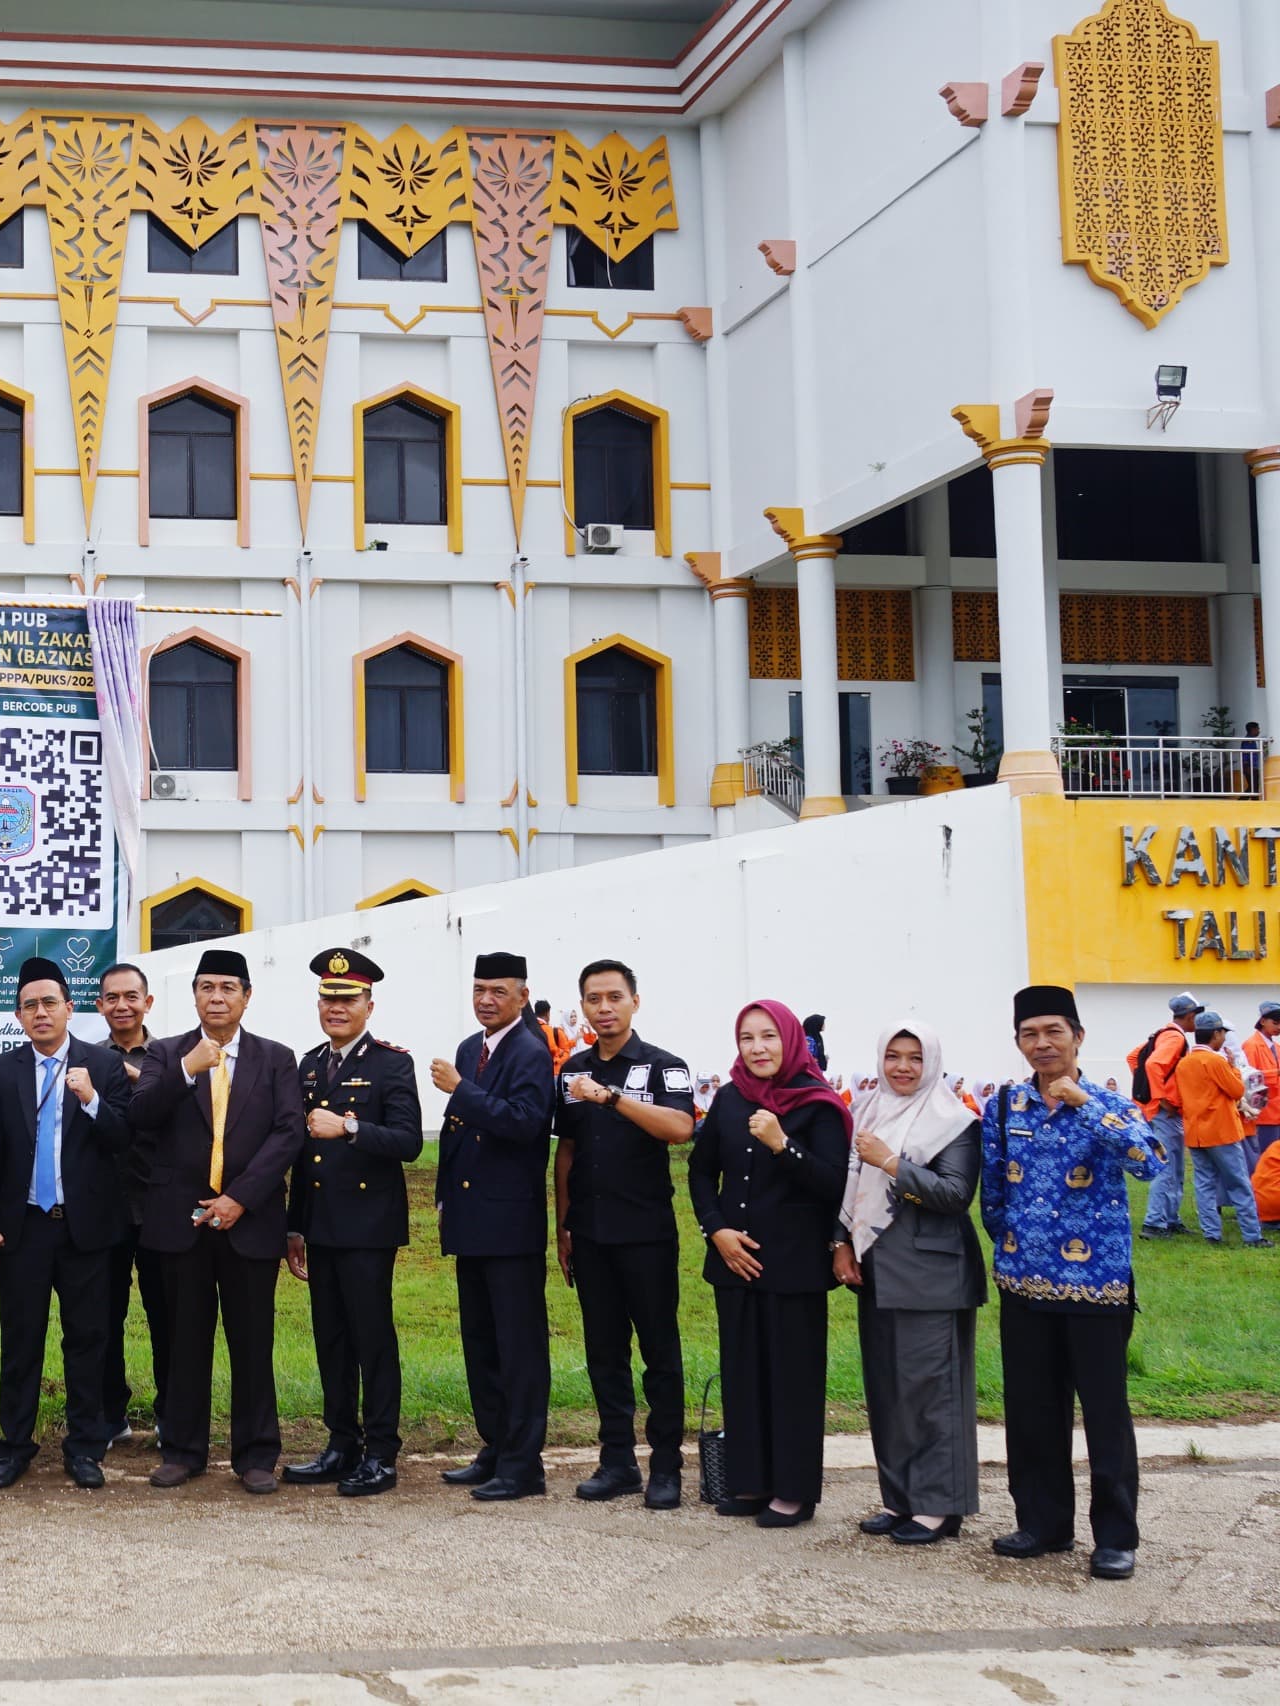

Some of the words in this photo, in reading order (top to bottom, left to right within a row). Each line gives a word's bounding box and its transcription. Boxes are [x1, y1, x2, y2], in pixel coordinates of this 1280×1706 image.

[12, 612, 48, 627] PUB
[3, 701, 53, 712] BERCODE
[56, 703, 77, 714] PUB
[1120, 825, 1280, 887] KANT
[1162, 910, 1267, 960] TALI
